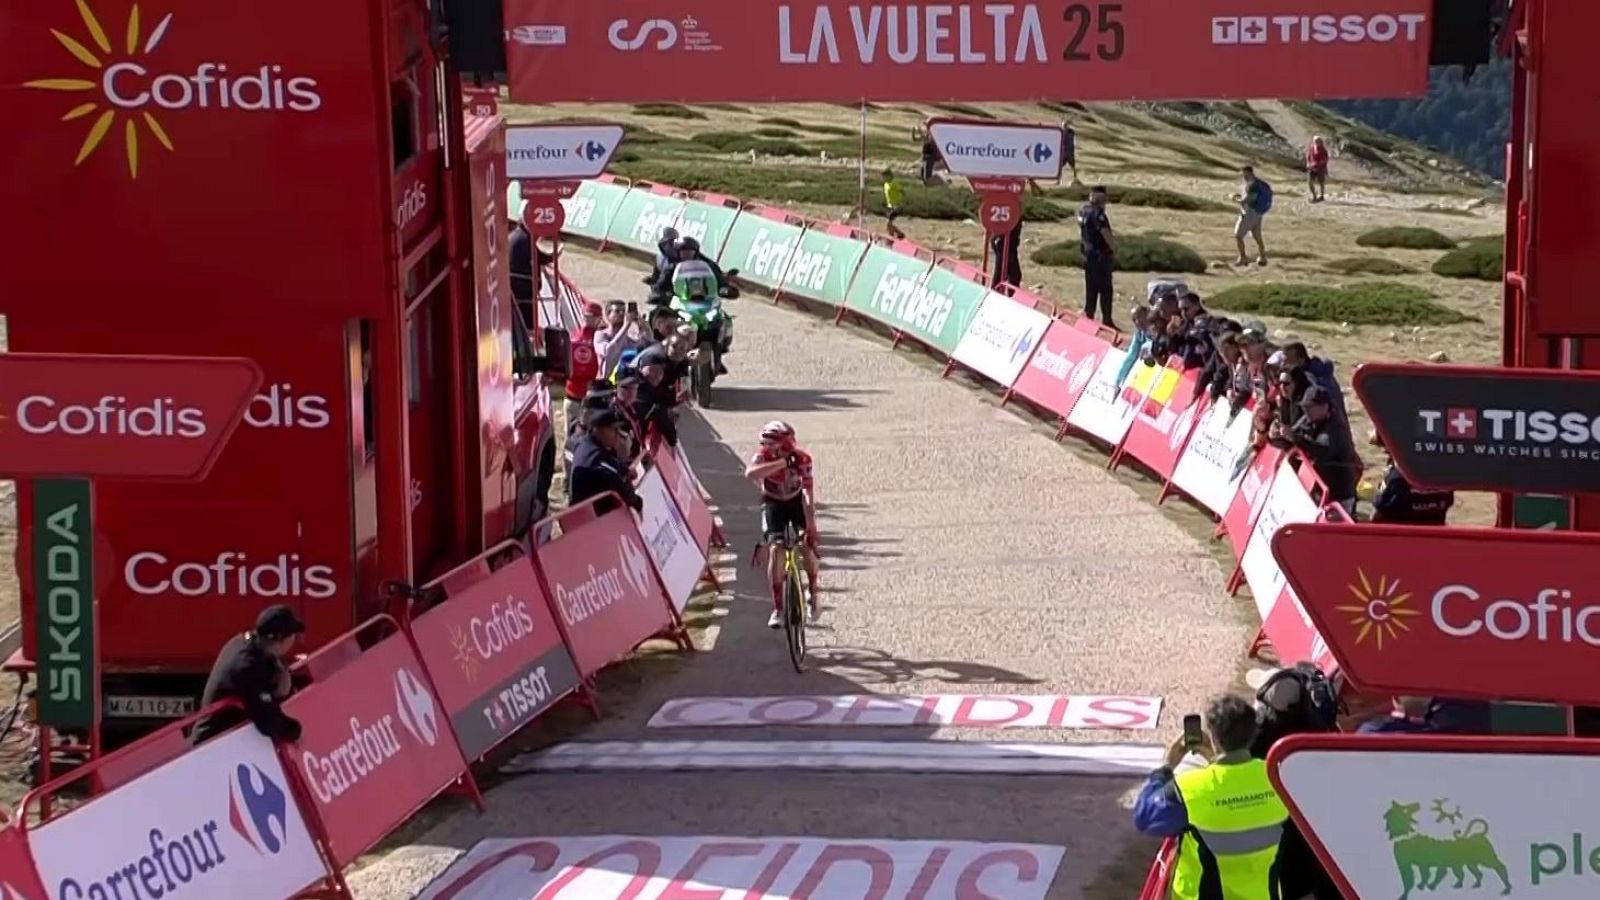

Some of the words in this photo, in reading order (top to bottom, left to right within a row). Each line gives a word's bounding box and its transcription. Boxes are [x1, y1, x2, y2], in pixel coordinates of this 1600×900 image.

[778, 5, 841, 63] LA
[849, 5, 1048, 63] VUELTA
[1062, 3, 1125, 62] 25
[1272, 14, 1425, 42] TISSOT
[102, 62, 321, 112] Cofidis
[945, 141, 1018, 158] Carrefour
[533, 208, 556, 223] 25
[989, 205, 1011, 221] 25
[16, 396, 206, 436] Cofidis
[1483, 409, 1600, 443] TISS
[1414, 442, 1465, 454] SWISS
[1473, 445, 1552, 458] WATCHES
[125, 552, 337, 598] Cofidis
[556, 564, 625, 626] Carrefour
[470, 594, 534, 659] Cofidis
[499, 666, 552, 721] TISSOT
[662, 697, 1151, 726] COFIDIS
[303, 714, 401, 803] Carrefour
